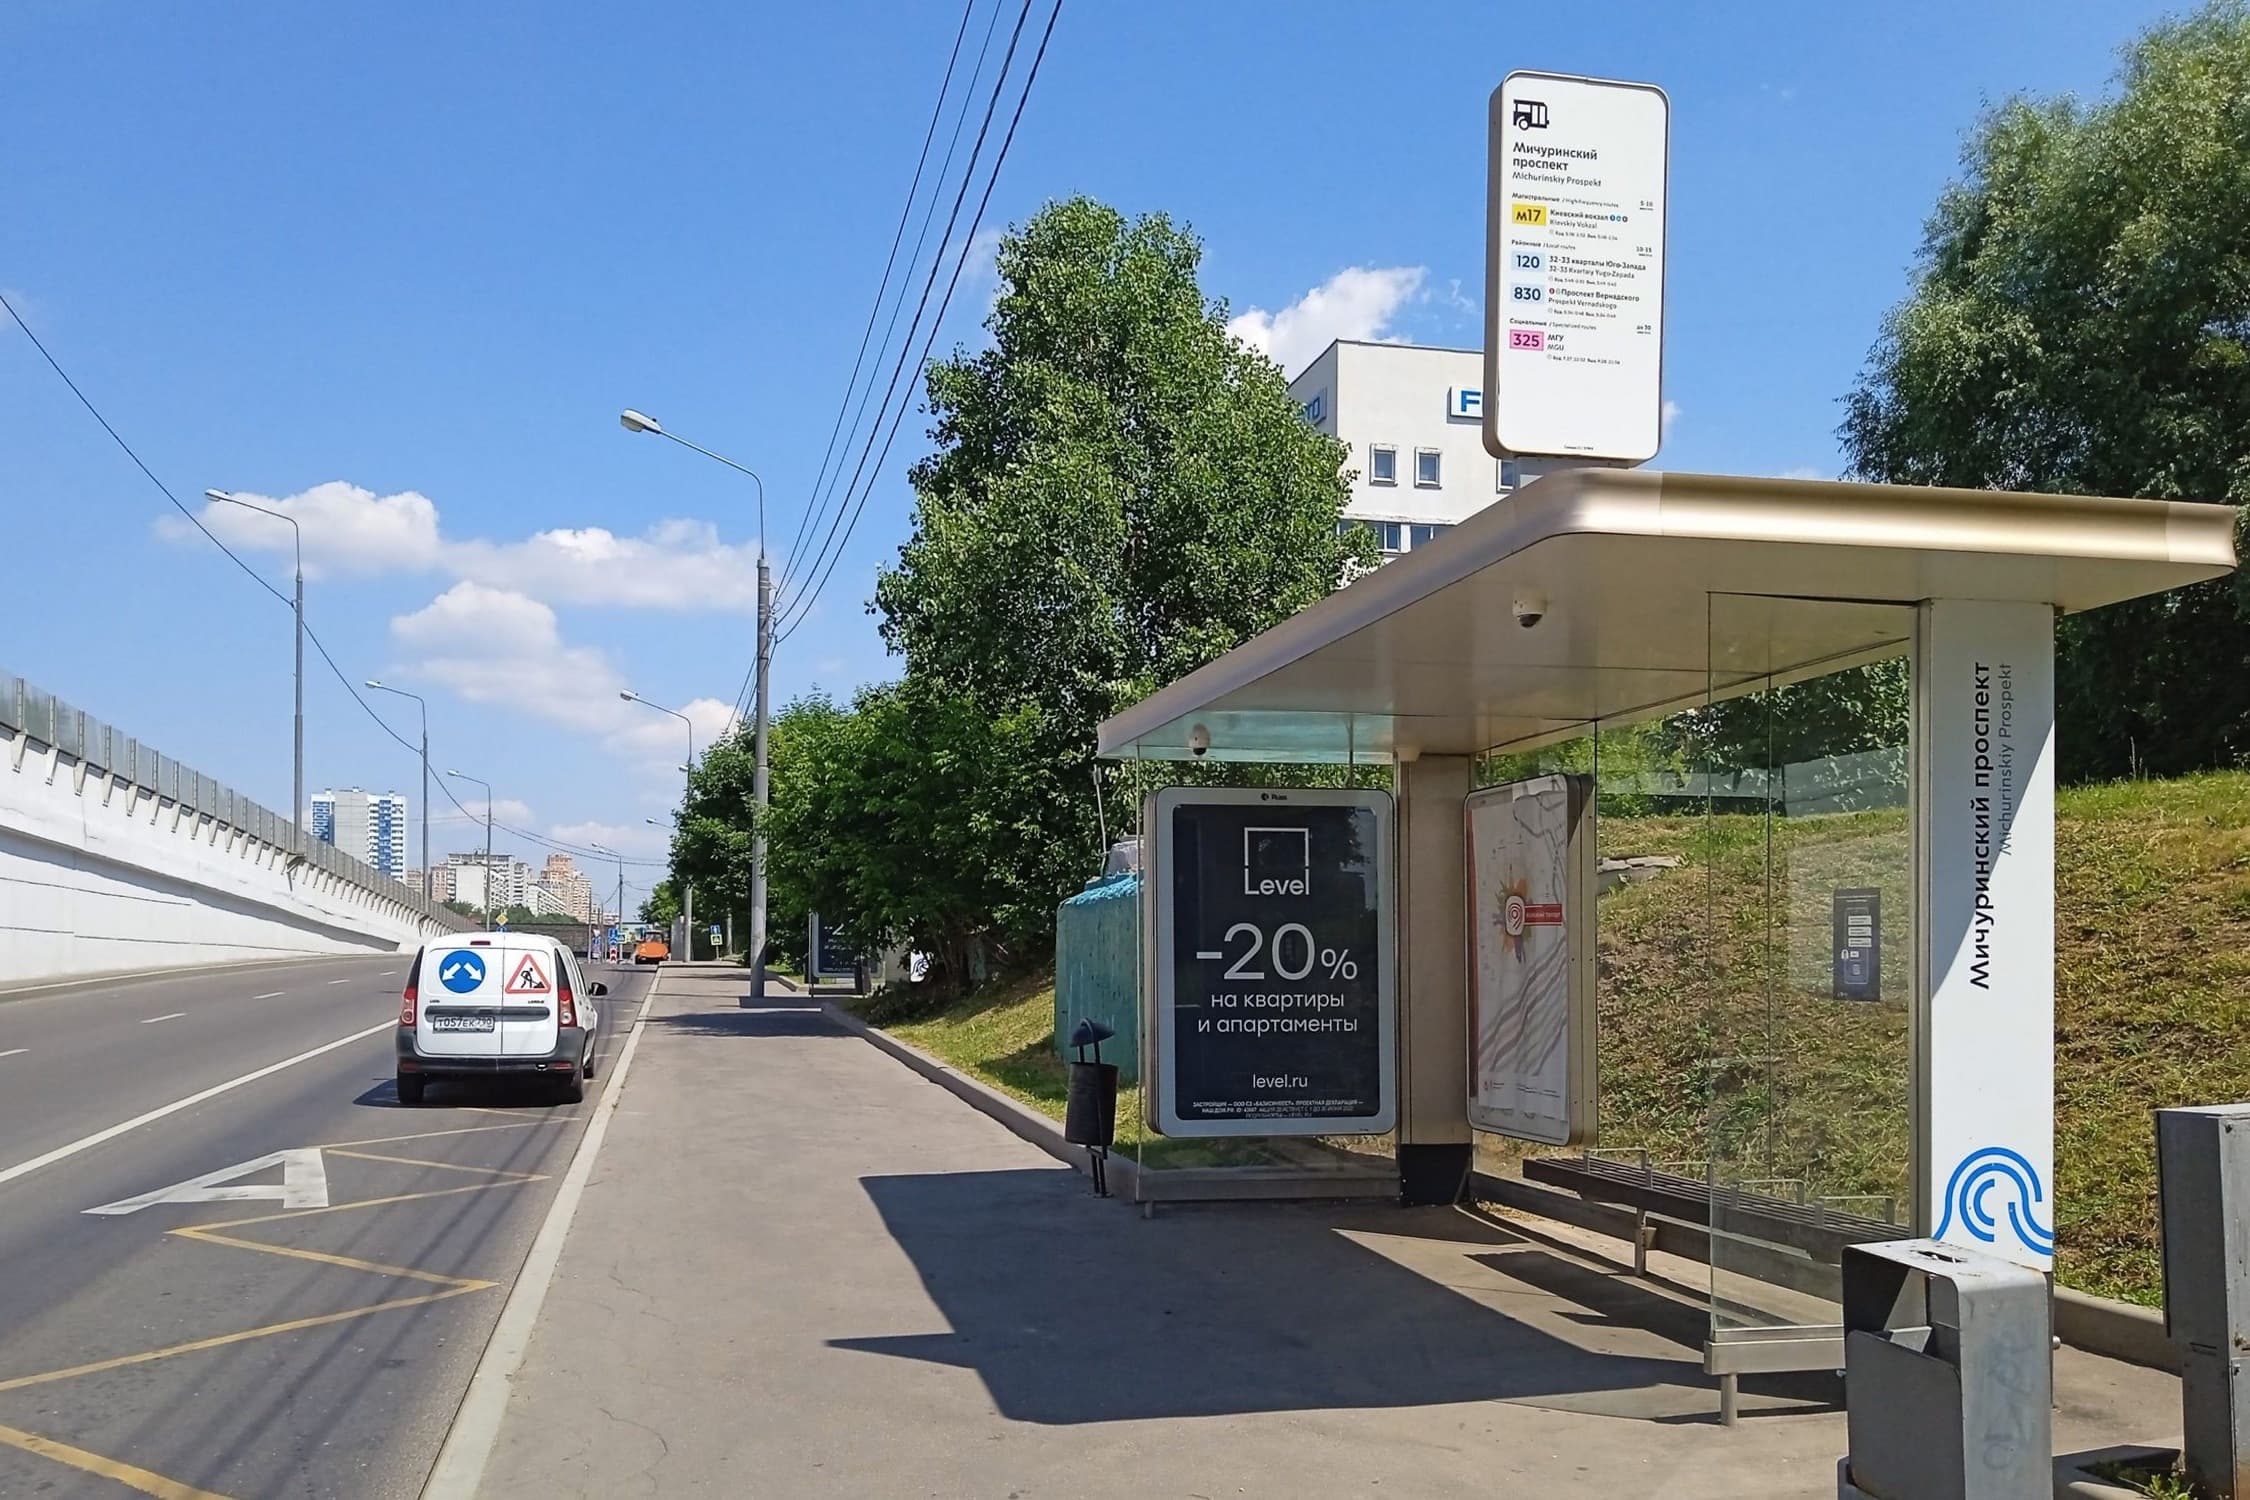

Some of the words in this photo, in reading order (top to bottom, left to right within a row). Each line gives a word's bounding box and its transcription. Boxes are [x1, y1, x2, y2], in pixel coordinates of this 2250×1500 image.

[1512, 141, 1598, 160] Мичуринский
[1512, 158, 1569, 171] проспект
[1512, 171, 1566, 185] Michurinskiy
[1566, 176, 1602, 187] Prospekt
[1550, 208, 1584, 218] Киевский
[1584, 213, 1609, 221] вокзал
[1516, 255, 1540, 269] 120
[1549, 255, 1571, 265] 32-33
[1571, 257, 1605, 267] кварталы
[1514, 286, 1541, 301] 830
[1561, 288, 1595, 299] Проспект
[1595, 291, 1640, 303] Вернадского
[1513, 333, 1540, 348] 325
[1547, 333, 1565, 342] МГУ
[1998, 663, 2013, 739] Prospekt
[1974, 662, 1994, 788] проспект
[1998, 743, 2015, 857] Michurinskiy
[1244, 868, 1310, 895] Level
[1970, 797, 1994, 990] Мичуринский
[1211, 993, 1237, 1008] на
[1244, 993, 1345, 1012] квартиры
[1198, 1018, 1210, 1033] и
[1217, 1017, 1358, 1037] апартаменты
[1252, 1073, 1308, 1089] level.ru
